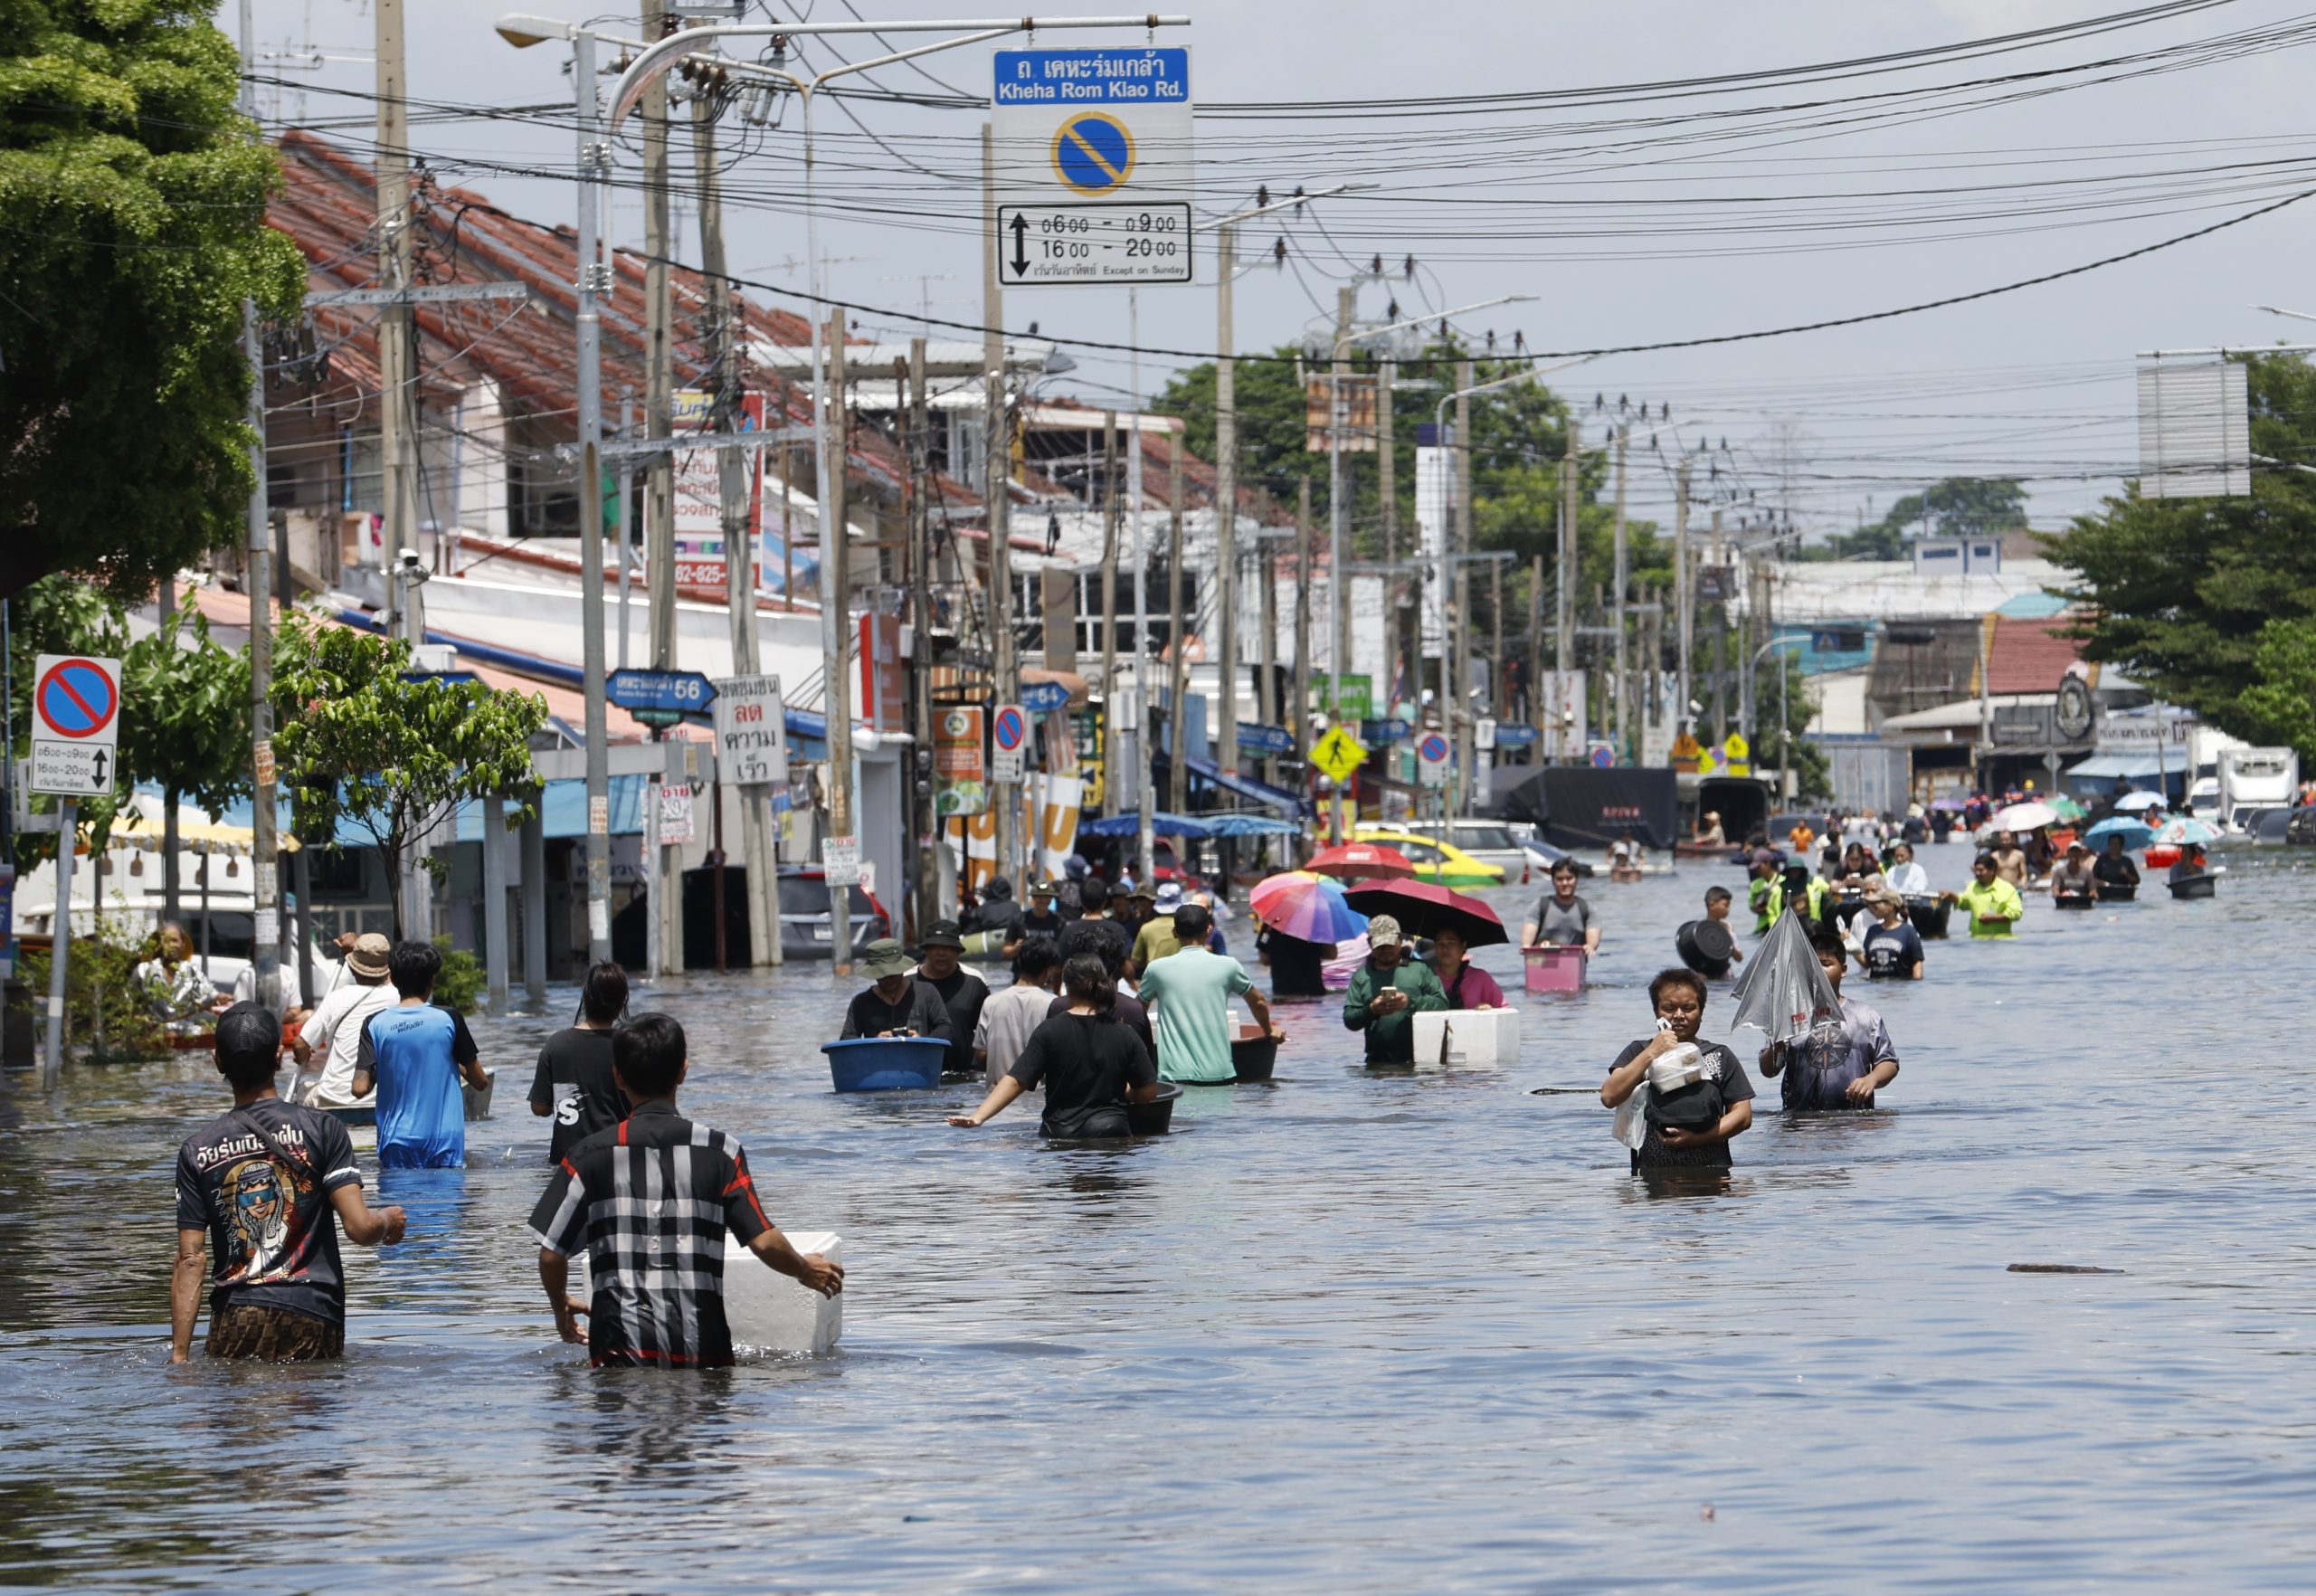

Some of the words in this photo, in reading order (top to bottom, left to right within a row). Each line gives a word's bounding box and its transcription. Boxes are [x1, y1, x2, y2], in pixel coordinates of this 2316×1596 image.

[1044, 51, 1165, 79] เคหะร่มเกล้า
[999, 83, 1056, 100] Kheha
[1061, 82, 1103, 99] Rom
[1108, 81, 1149, 98] Klao
[1154, 81, 1184, 97] Rd.
[1103, 265, 1134, 276] Except
[1137, 266, 1149, 274] on
[1152, 265, 1185, 276] Sunday
[674, 679, 700, 700] 56
[714, 678, 778, 702] ขตชุมชน
[734, 703, 763, 724] ลด
[725, 729, 776, 750] ความ
[737, 753, 768, 781] เร็ว
